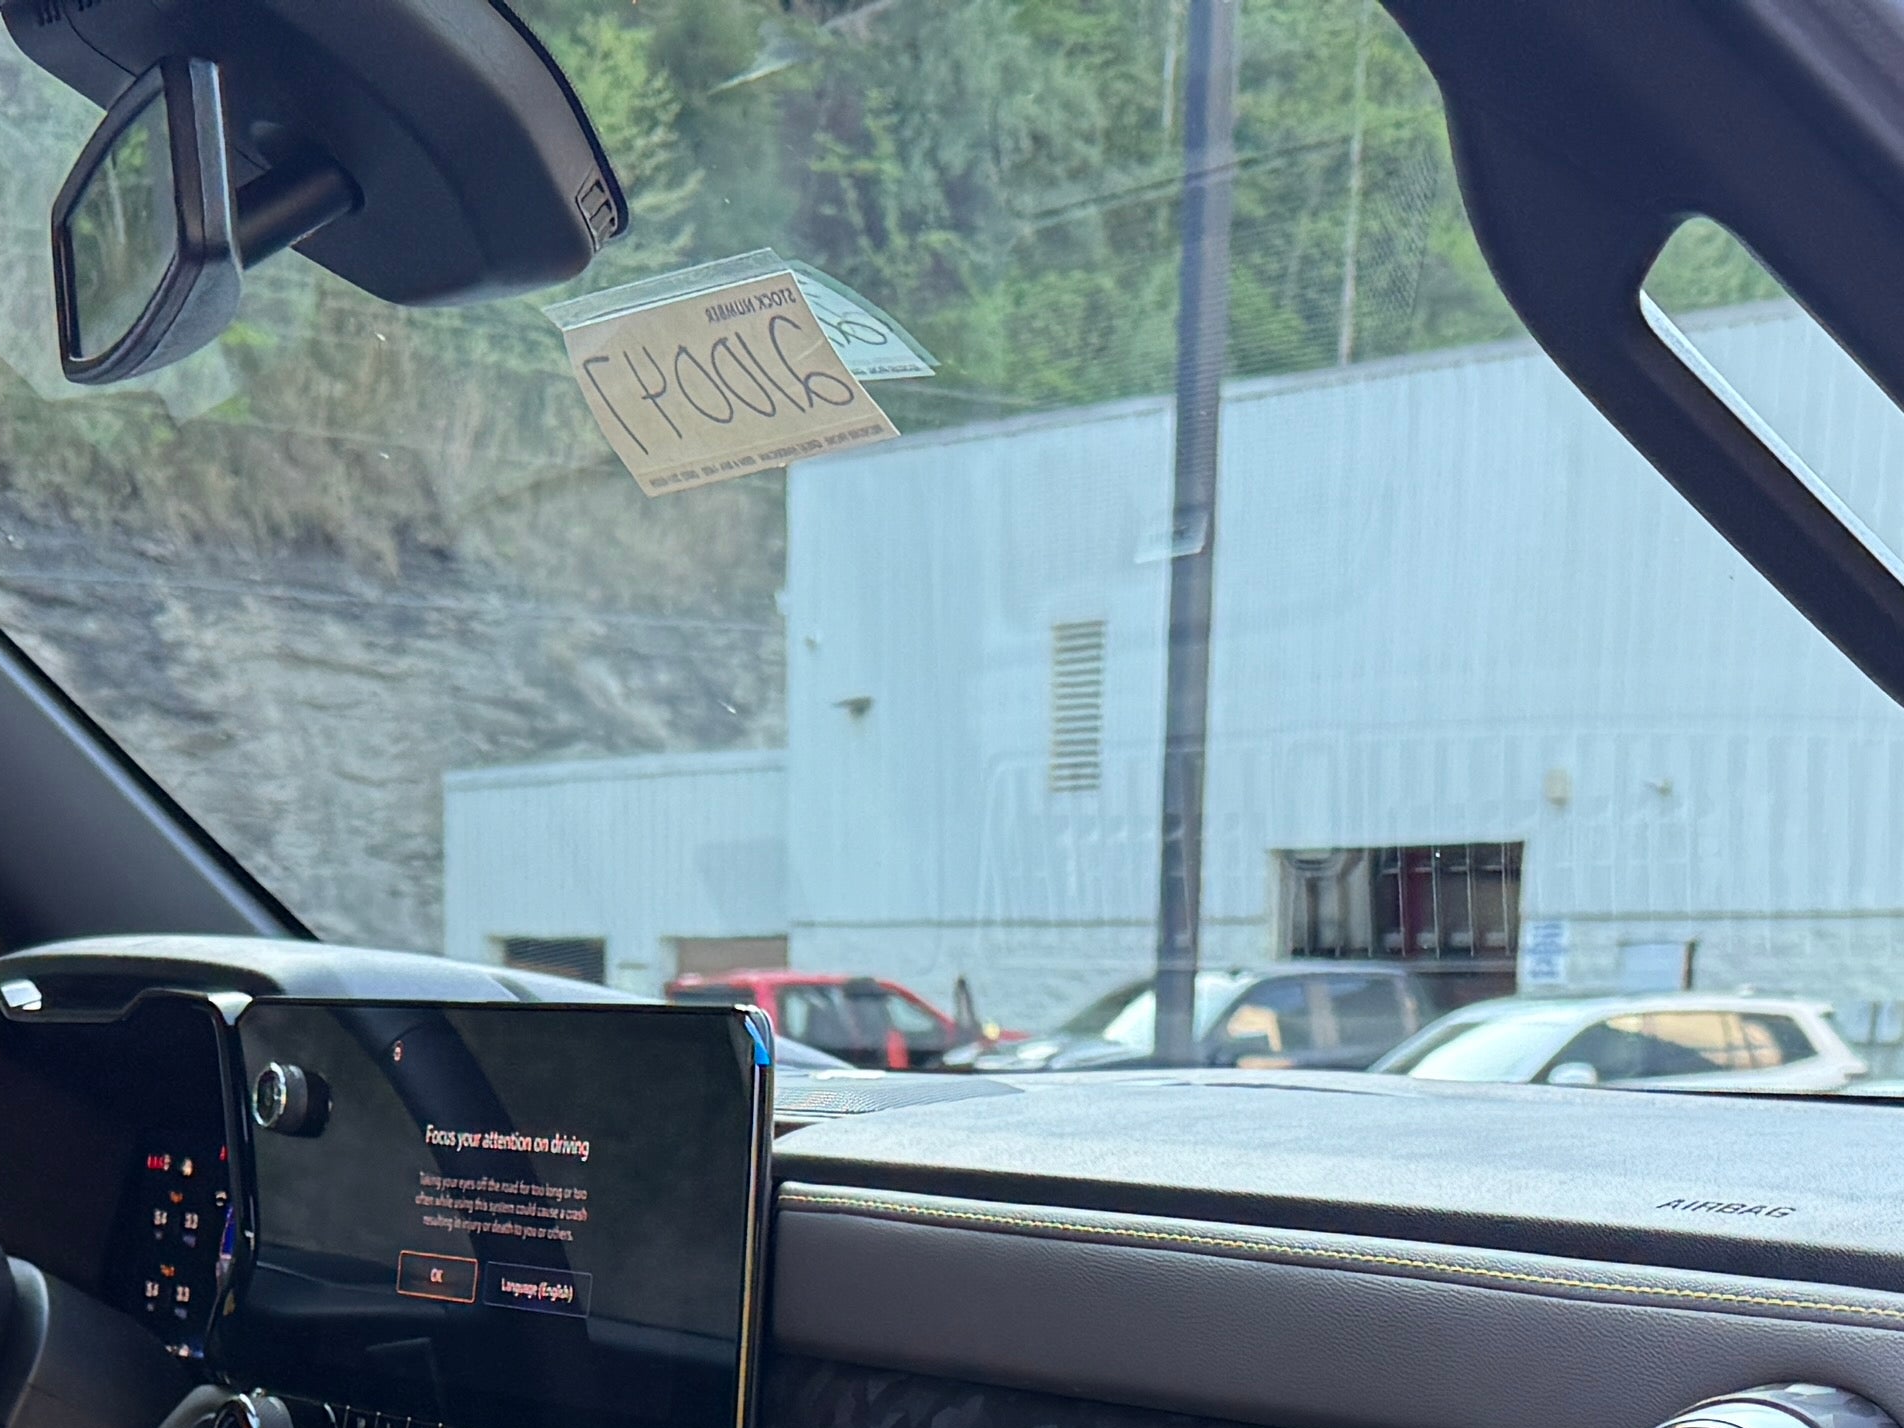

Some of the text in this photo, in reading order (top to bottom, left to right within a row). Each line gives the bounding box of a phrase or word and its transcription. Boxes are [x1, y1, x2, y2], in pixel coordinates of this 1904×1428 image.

[425, 1123, 590, 1161] Focus your attention on driving
[1655, 1198, 1797, 1219] AIRBAG
[501, 1277, 574, 1304] Language (English)
